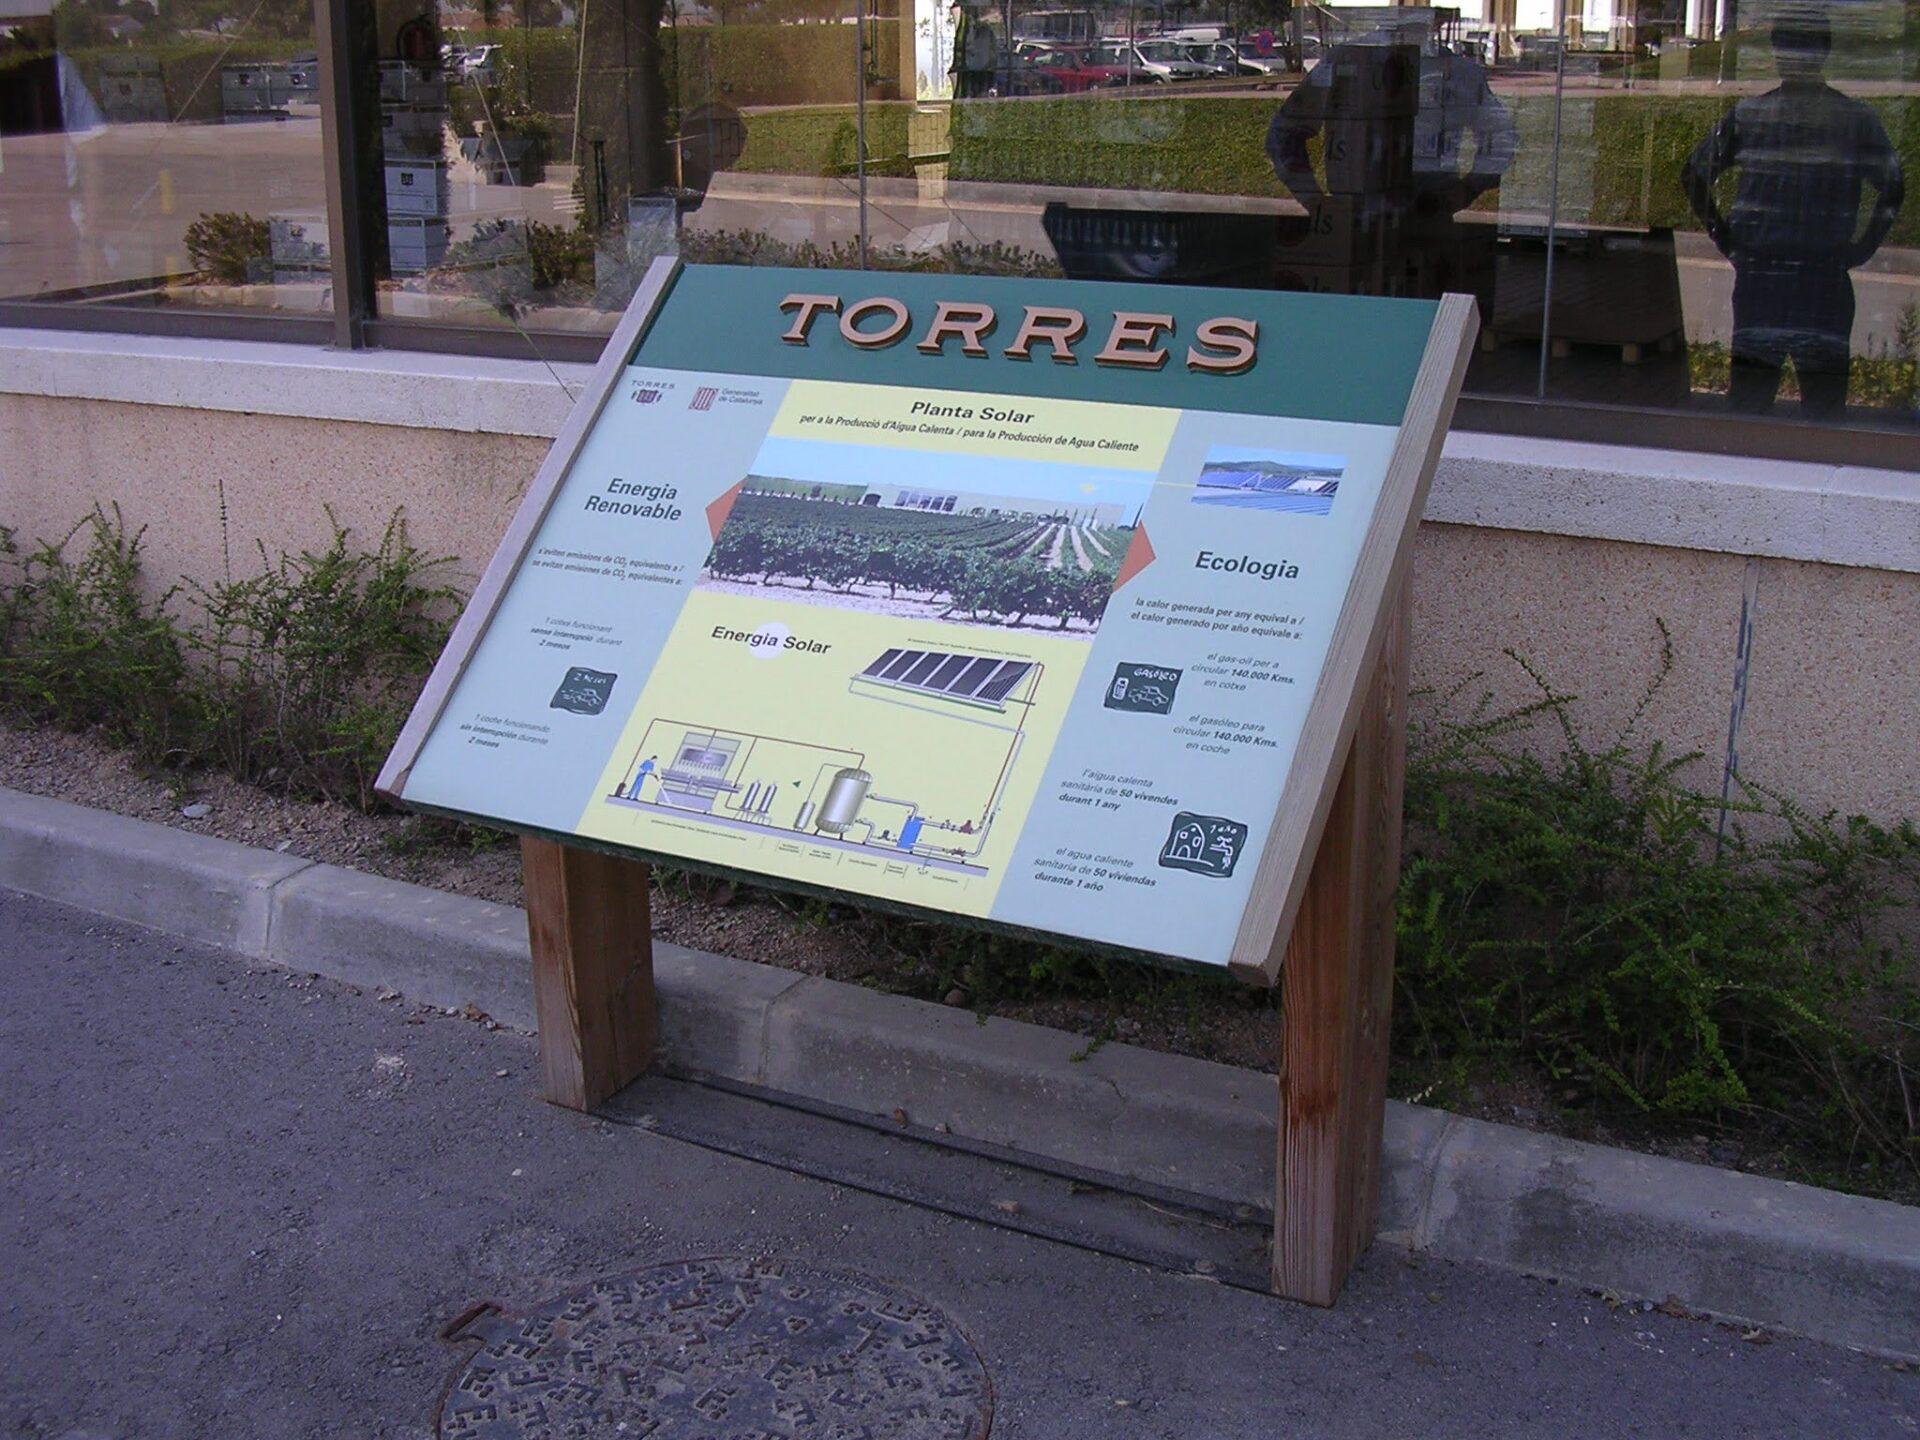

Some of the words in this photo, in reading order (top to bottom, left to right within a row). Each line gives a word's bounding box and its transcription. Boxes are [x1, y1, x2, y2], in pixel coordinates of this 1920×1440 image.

[779, 293, 1258, 375] TORRES
[631, 380, 675, 390] TORRES
[910, 401, 973, 419] Planta
[979, 408, 1035, 424] Solar
[800, 415, 816, 424] per
[824, 416, 833, 425] la
[835, 417, 880, 429] Producció
[918, 423, 954, 436] Calenta
[962, 428, 984, 439] para
[986, 429, 996, 439] la
[998, 430, 1052, 444] Producción
[1055, 436, 1067, 446] de
[1068, 436, 1095, 449] Agua
[1097, 439, 1139, 452] Caliente
[607, 478, 677, 500] Energia
[584, 495, 682, 521] Renovable
[1195, 550, 1299, 580] Ecologia
[1136, 598, 1145, 606] la
[1146, 600, 1170, 609] calor
[1171, 602, 1214, 615] generada
[1215, 608, 1233, 617] per
[1234, 611, 1253, 621] any
[1254, 612, 1289, 625] equival
[1130, 611, 1140, 620] el
[1141, 612, 1165, 623] calor
[1166, 616, 1210, 629] generado
[1211, 622, 1229, 631] por
[1230, 623, 1249, 633] año
[1251, 626, 1291, 639] equivale
[711, 625, 778, 647] Energia
[783, 635, 832, 656] Solar
[1207, 652, 1216, 661] el
[1254, 658, 1270, 669] per
[1272, 661, 1279, 669] a
[1191, 663, 1230, 675] circular
[1231, 669, 1270, 681] 140.000
[1204, 678, 1217, 687] en
[1219, 681, 1246, 691] cotxe
[1189, 714, 1200, 723] el
[1200, 717, 1241, 730] gasóleo
[1241, 722, 1265, 733] para
[1173, 726, 1211, 737] circular
[1214, 731, 1252, 744] 140.000
[1186, 741, 1199, 750] en
[1201, 744, 1231, 755] coche
[1117, 775, 1153, 788] calenta
[1059, 793, 1092, 806] durant
[1094, 798, 1101, 807] 1
[1101, 801, 1121, 811] any
[1104, 787, 1118, 796] de
[1119, 788, 1133, 798] 50
[1134, 792, 1179, 806] vivendes
[1056, 847, 1067, 856] el
[1067, 850, 1092, 861] agua
[1094, 854, 1134, 869] caliente
[1034, 871, 1074, 886] durante
[1076, 879, 1083, 888] 1
[1083, 880, 1104, 892] año
[1078, 865, 1092, 875] de
[1093, 868, 1107, 878] 50
[1108, 870, 1157, 887] viviendas
